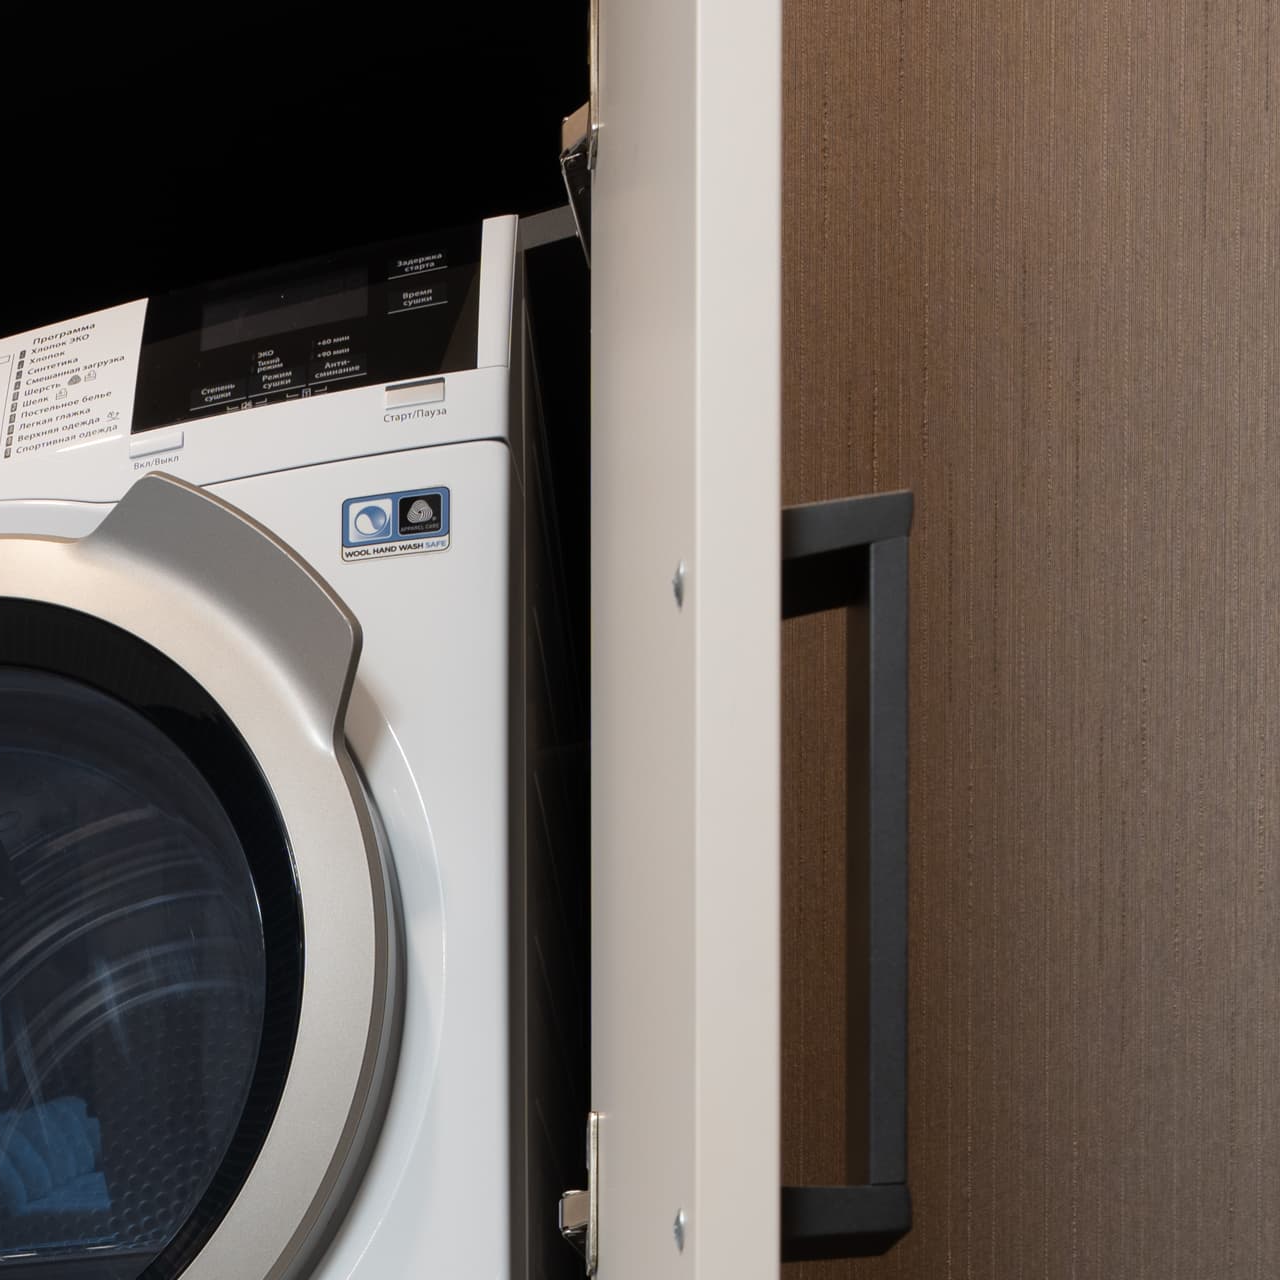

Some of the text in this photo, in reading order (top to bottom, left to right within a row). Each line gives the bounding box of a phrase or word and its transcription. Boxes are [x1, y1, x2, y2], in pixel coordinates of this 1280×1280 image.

[396, 253, 443, 267] Задержка
[402, 288, 433, 300] Время
[402, 295, 433, 307] сушки
[32, 323, 96, 345] Программа
[333, 335, 351, 343] мин
[31, 333, 90, 355] Хлопок ЭКО
[29, 351, 66, 364] Хлопок
[257, 349, 275, 359] ЭКО
[333, 347, 351, 356] мин
[25, 355, 126, 386] Смешанная загрузка
[27, 357, 79, 375] Синтетика
[314, 365, 361, 379] сминание
[262, 370, 293, 381] Режим
[23, 382, 62, 397] Шерсть
[200, 383, 236, 396] Степень
[262, 379, 292, 390] сушки
[22, 396, 49, 408] Шелк
[204, 391, 232, 402] сушки
[20, 390, 113, 419] Постельное белье
[18, 407, 92, 431] Легкая глажка
[382, 406, 448, 424] Старт/Пауза
[17, 417, 101, 442] Верхняя одежда
[15, 424, 119, 454] Спортивная одежда
[132, 454, 180, 471] Вкл/Выкл
[345, 540, 447, 558] WOOL HAND WASH SAFE
